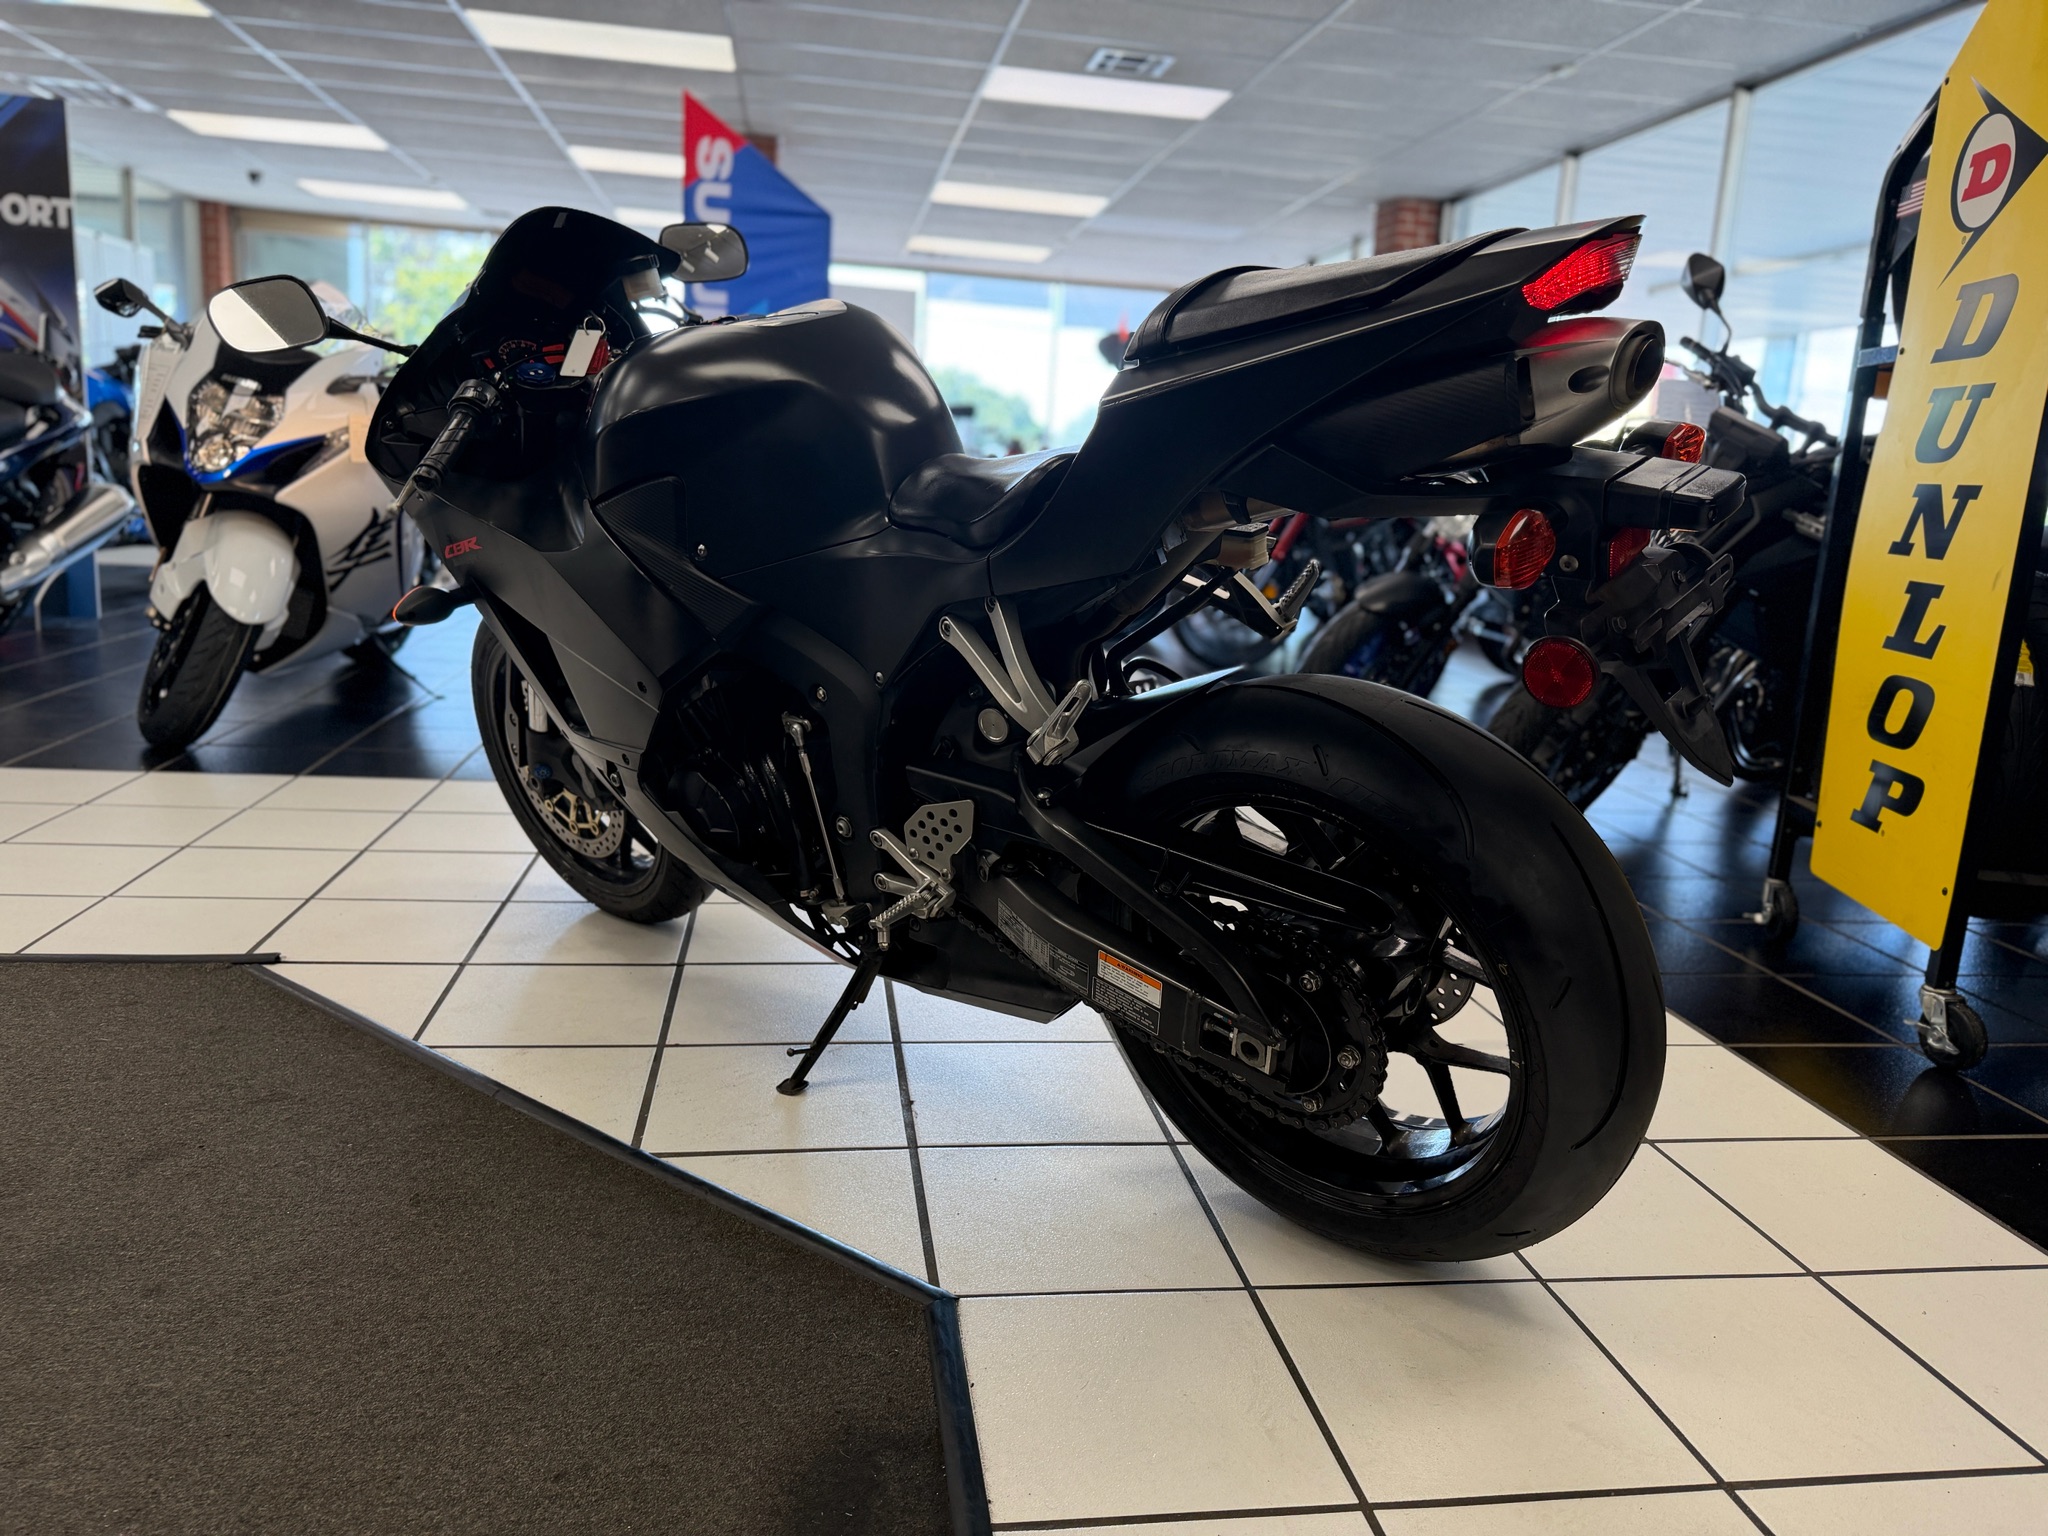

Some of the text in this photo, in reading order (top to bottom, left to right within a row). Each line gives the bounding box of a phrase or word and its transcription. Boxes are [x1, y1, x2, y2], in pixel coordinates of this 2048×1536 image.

[1961, 143, 2012, 203] D
[445, 536, 482, 559] CBR
[1850, 273, 2020, 834] DUNLOP
